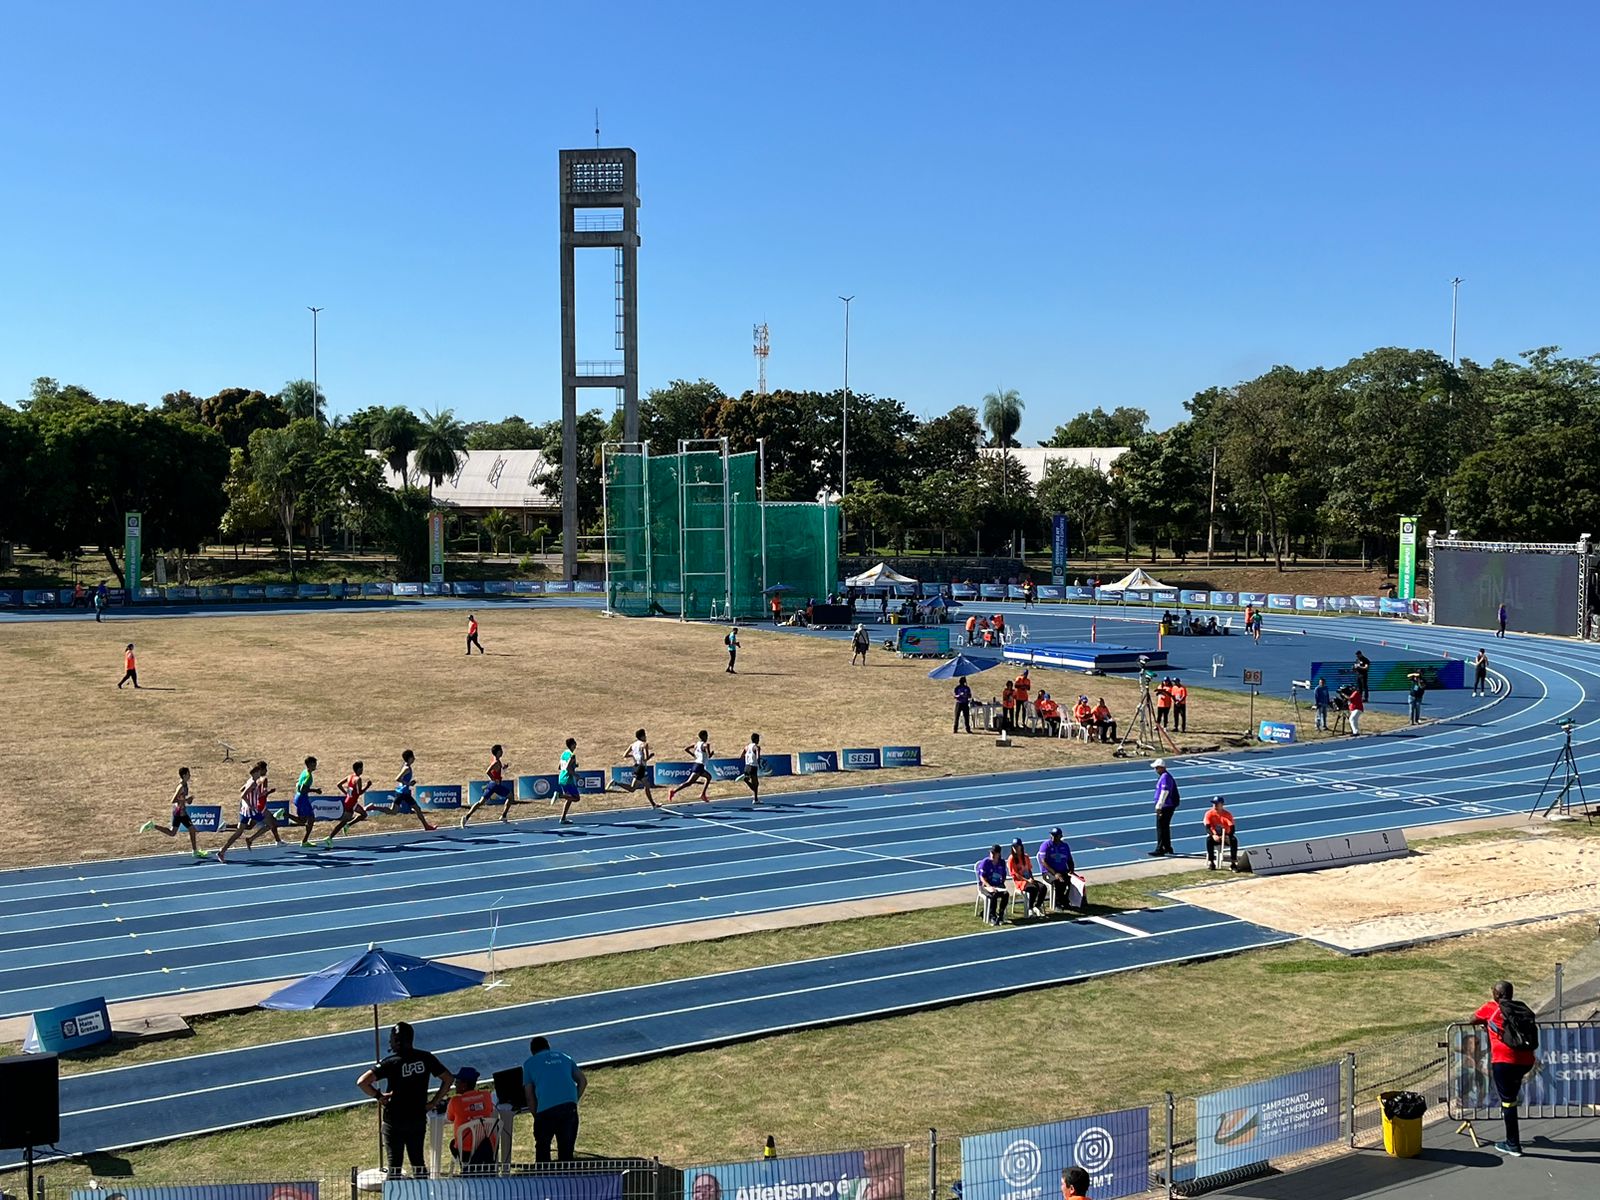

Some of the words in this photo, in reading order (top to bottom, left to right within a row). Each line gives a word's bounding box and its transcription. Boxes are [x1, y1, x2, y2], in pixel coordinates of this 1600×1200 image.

[1479, 575, 1524, 609] FINAL
[850, 754, 873, 763] SESI
[657, 768, 691, 778] Playpiso
[1265, 848, 1273, 860] 5
[1305, 843, 1313, 855] 6
[1345, 838, 1351, 849] 7
[1382, 833, 1389, 844] 8
[1261, 1093, 1309, 1113] CAMPEONATO
[1262, 1097, 1325, 1121] BERO-AMERICANO
[1311, 1106, 1328, 1118] 2024
[735, 1179, 834, 1200] Atletismo
[836, 1173, 849, 1195] é
